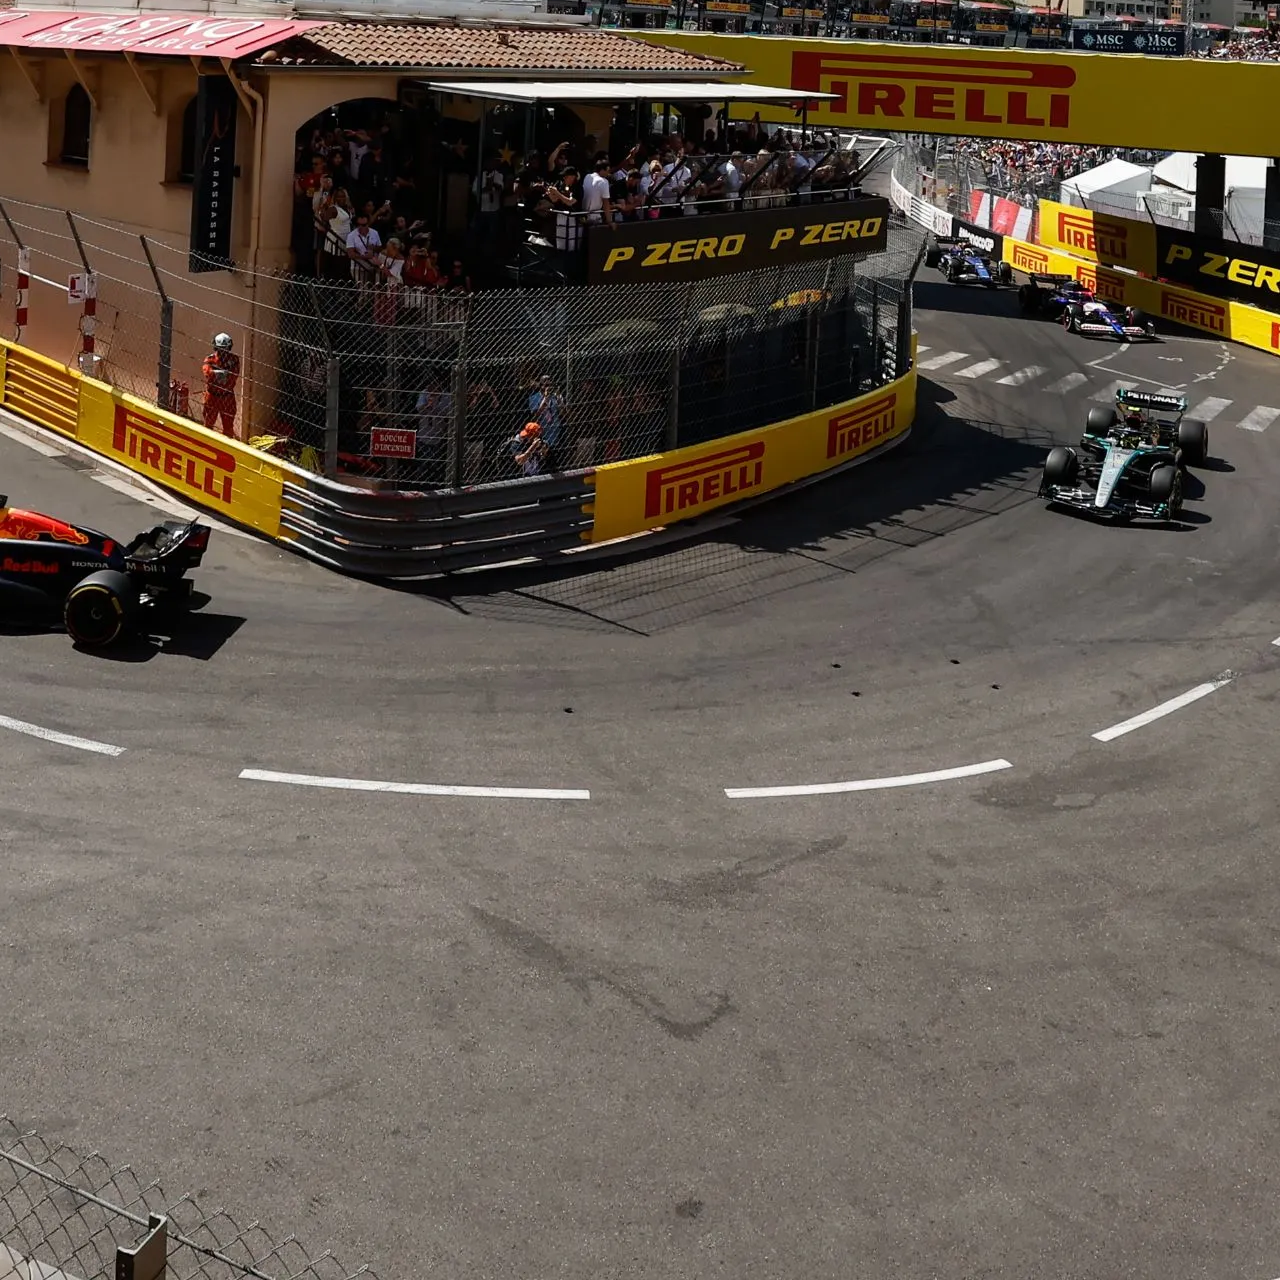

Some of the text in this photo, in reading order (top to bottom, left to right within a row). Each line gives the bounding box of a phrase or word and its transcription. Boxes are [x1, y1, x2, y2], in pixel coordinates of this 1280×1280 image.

[60, 16, 264, 38] CASINO
[1097, 35, 1123, 45] MSC
[791, 51, 1077, 129] PIRELLI
[209, 147, 220, 248] LA RASCASSE
[770, 217, 882, 249] P ZERO
[1058, 212, 1127, 260] PIRELLI
[603, 234, 746, 271] P ZERO
[1014, 244, 1048, 274] PIRELLI
[1165, 244, 1192, 265] P
[1161, 291, 1225, 332] PIRELLI
[1127, 391, 1177, 404] PETRONAS
[827, 393, 896, 458] PIRELLI
[113, 403, 236, 504] PIRELLI
[644, 441, 765, 519] PIRELLI
[3, 558, 59, 573] Red Bull
[71, 560, 109, 569] HONDA
[126, 562, 157, 572] Mbil
